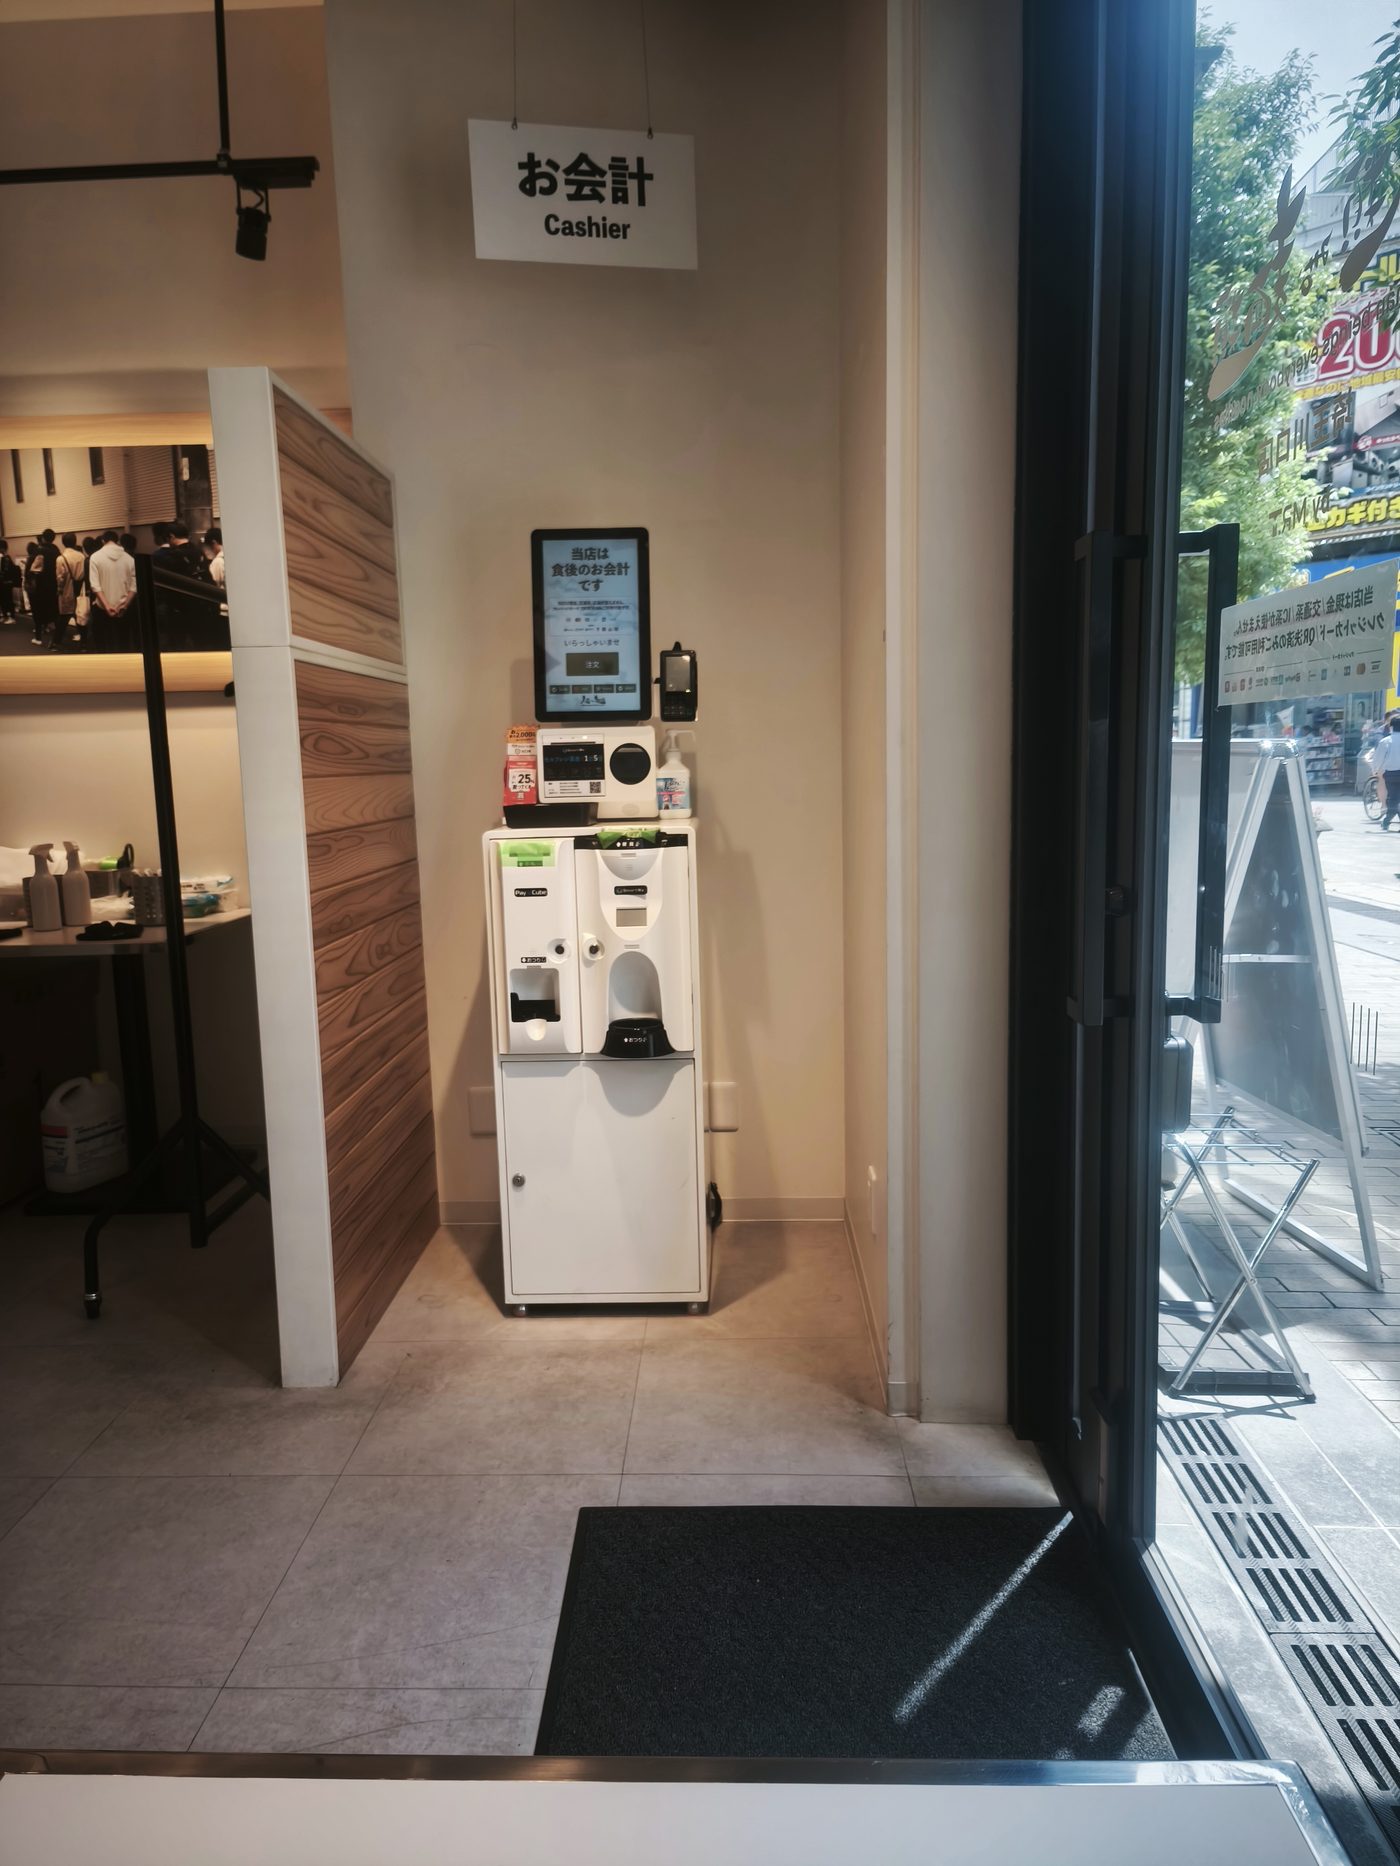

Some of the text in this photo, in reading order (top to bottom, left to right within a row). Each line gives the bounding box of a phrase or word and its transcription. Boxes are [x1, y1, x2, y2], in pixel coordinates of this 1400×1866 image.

[517, 151, 654, 207] お会計
[544, 213, 631, 240] Cashier
[571, 547, 610, 561] 当店は
[551, 562, 630, 578] 食後のお会計
[579, 579, 604, 592] です
[564, 638, 620, 648] いらっしゃいませ
